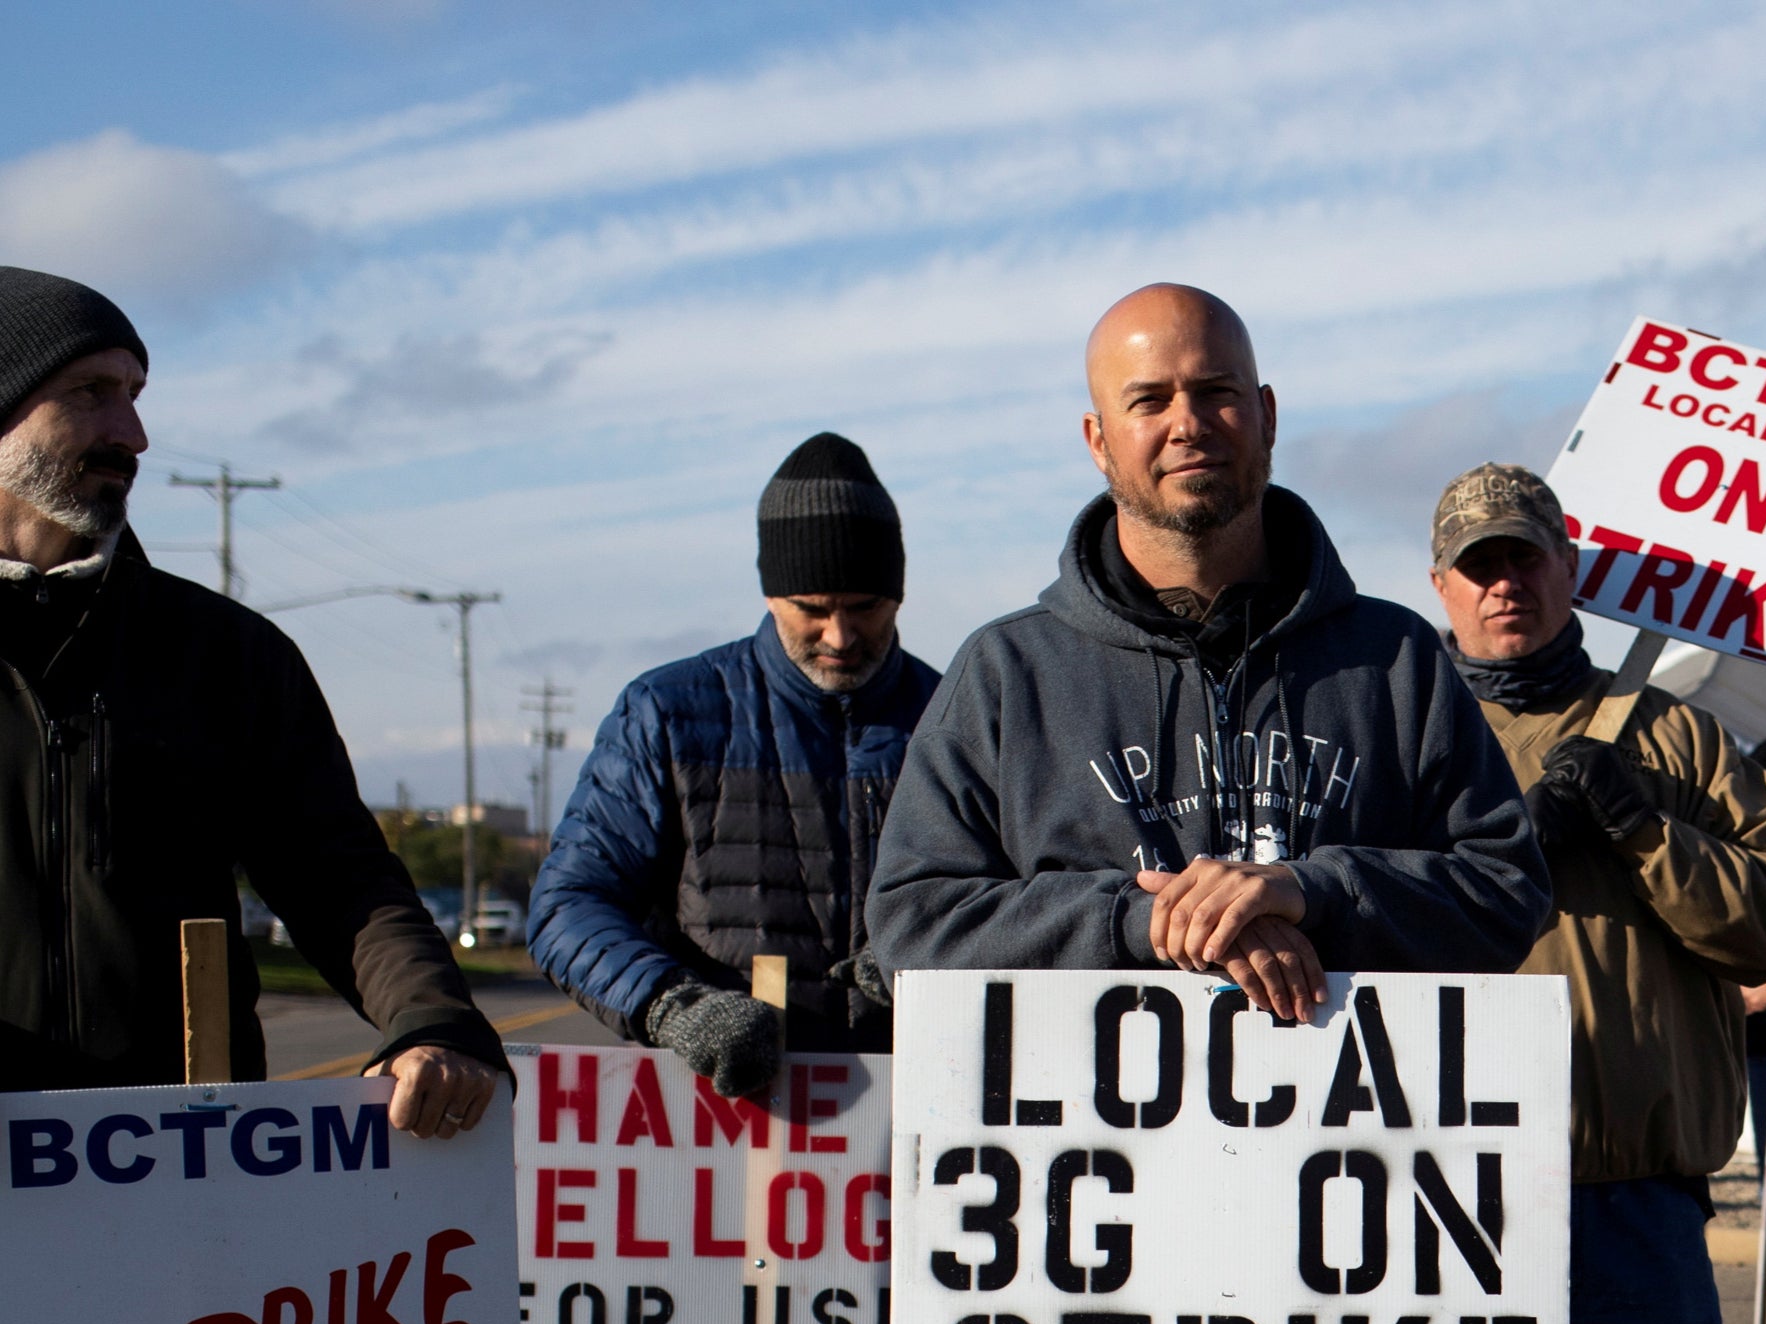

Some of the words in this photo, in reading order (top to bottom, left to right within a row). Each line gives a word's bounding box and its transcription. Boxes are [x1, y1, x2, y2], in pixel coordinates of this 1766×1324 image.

[1089, 745, 1152, 804] UP
[1195, 730, 1361, 809] NORTH
[1247, 791, 1322, 819] RADITON
[981, 981, 1520, 1128] LOCAL
[8, 1102, 391, 1189] BCTGM
[538, 1053, 849, 1153] HAME
[535, 1167, 892, 1263] ELLOG
[930, 1146, 1134, 1293] 3G
[1298, 1149, 1503, 1296] ON
